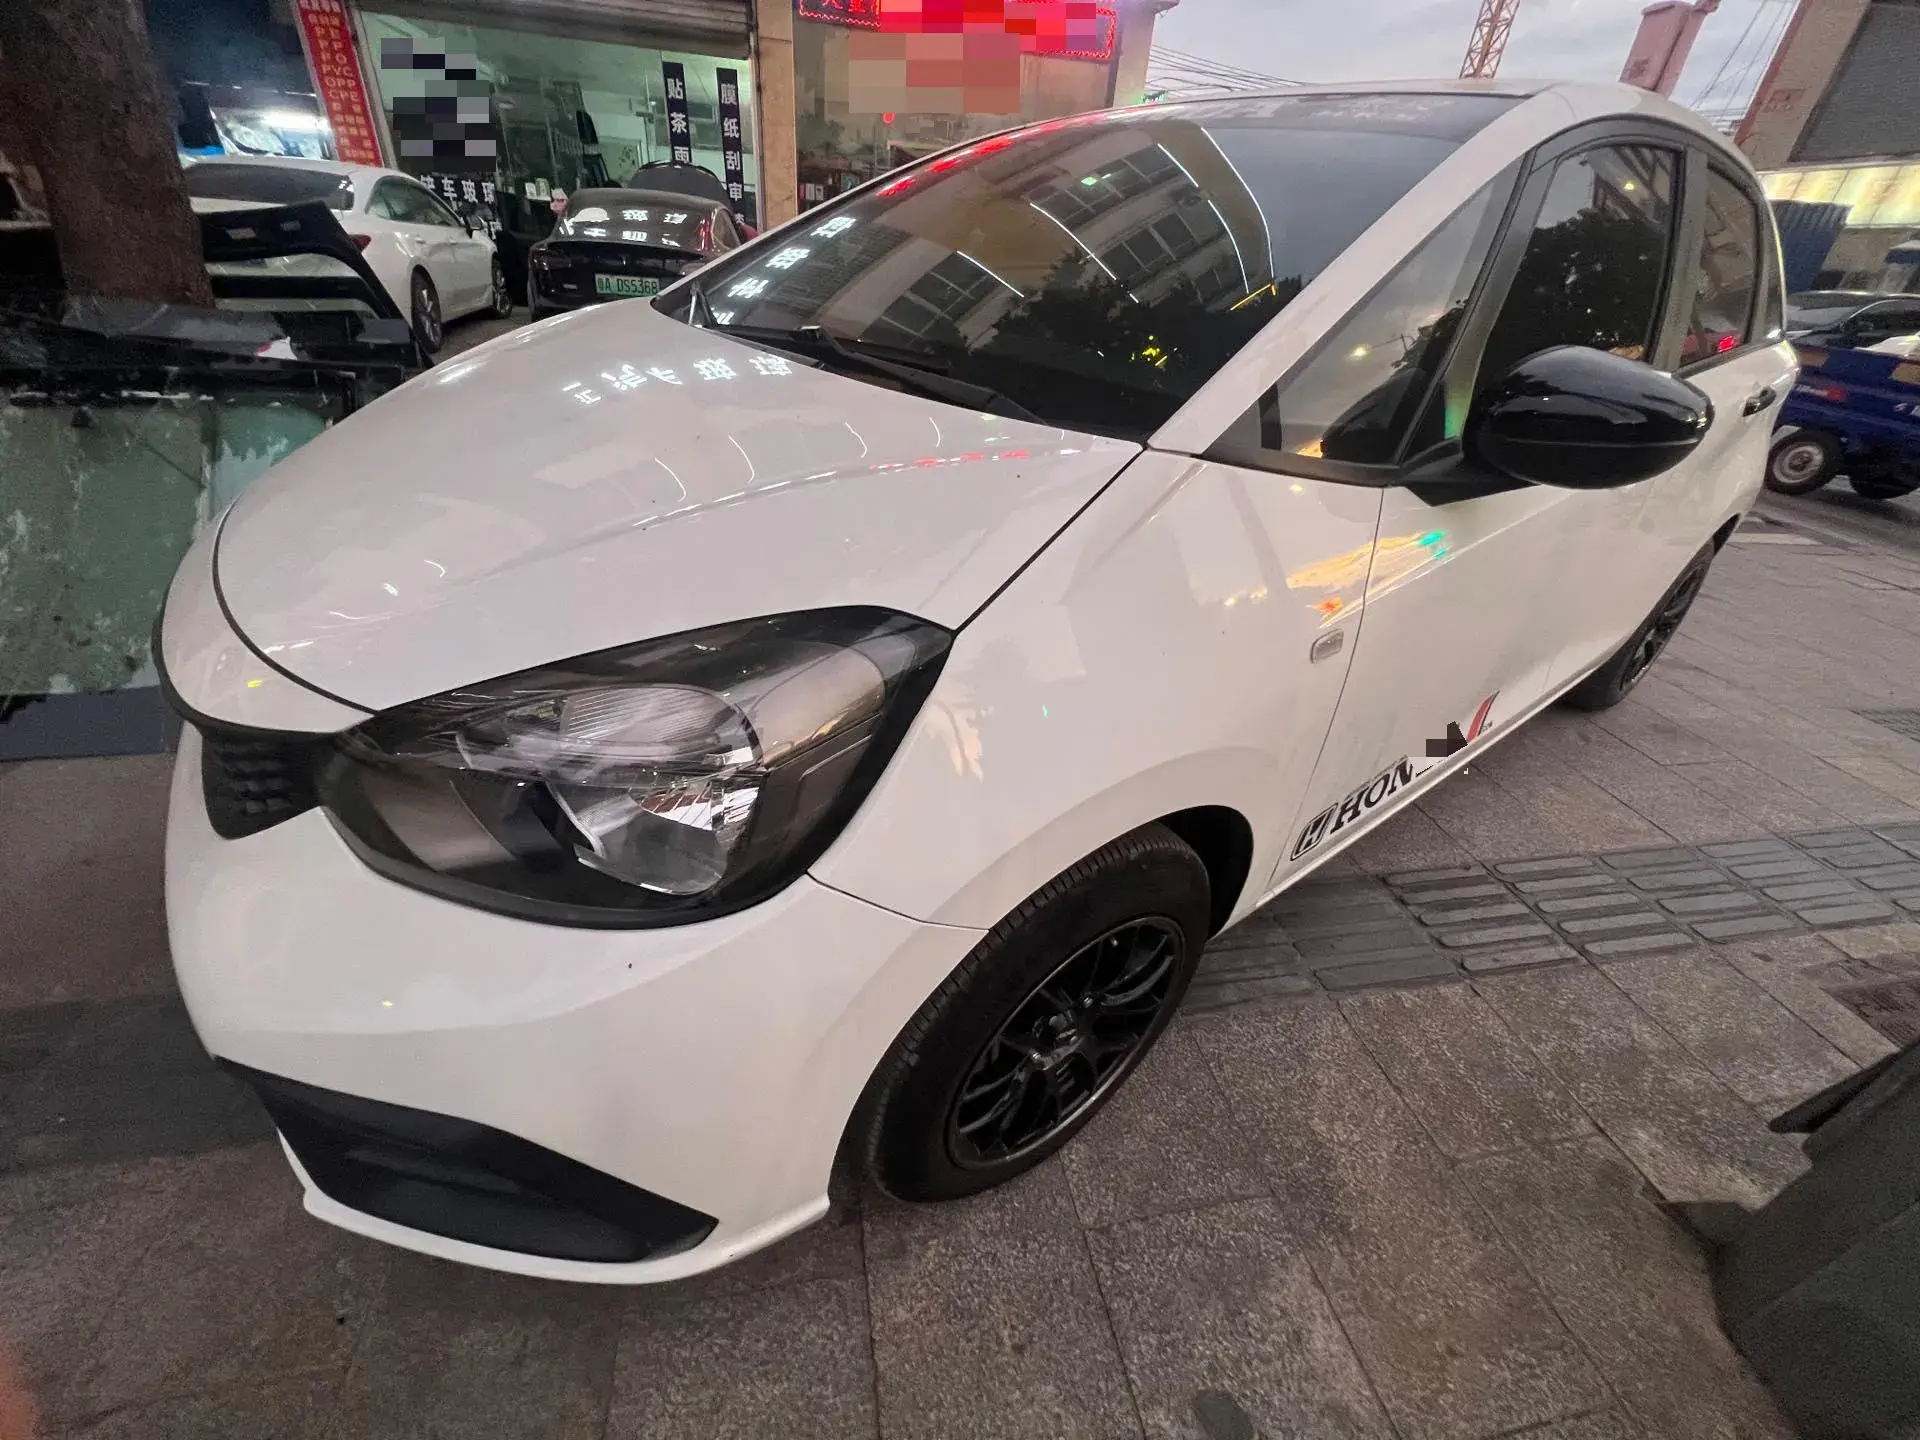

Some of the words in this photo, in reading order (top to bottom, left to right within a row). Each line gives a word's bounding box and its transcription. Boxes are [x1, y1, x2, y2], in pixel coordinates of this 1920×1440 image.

[321, 64, 354, 78] PVC
[325, 77, 357, 89] OPP
[667, 77, 690, 164] 贴茶雨
[616, 277, 658, 294] DS5368
